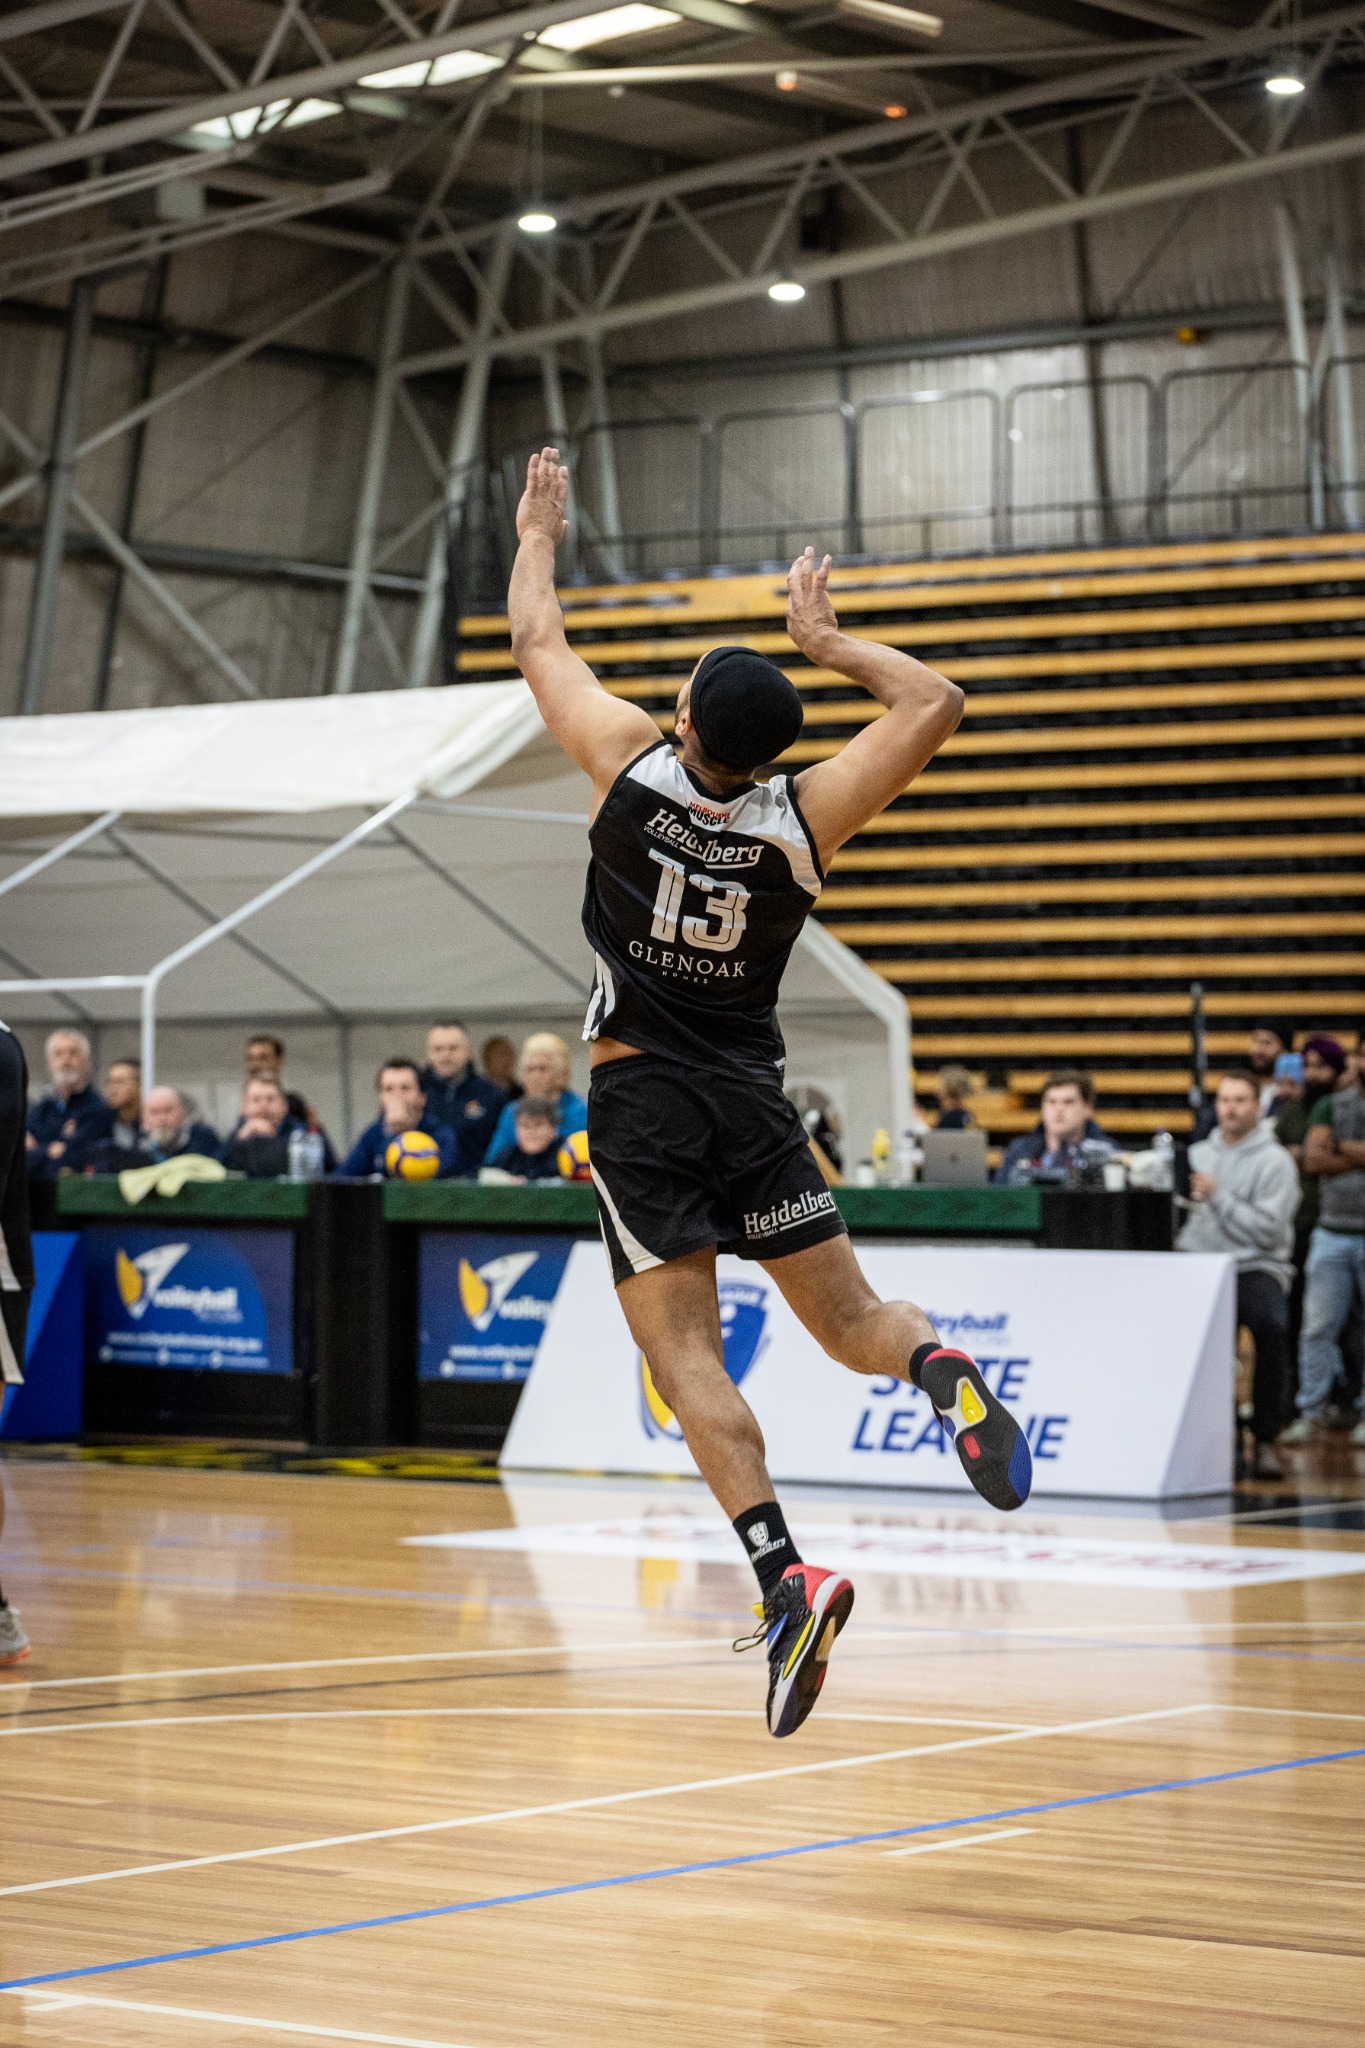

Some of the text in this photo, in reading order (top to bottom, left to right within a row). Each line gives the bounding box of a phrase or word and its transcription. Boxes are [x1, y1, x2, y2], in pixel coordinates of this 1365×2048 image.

[688, 805, 730, 827] MUSCLE
[689, 801, 731, 819] MELBOURNE
[643, 825, 679, 848] VOLLEYBALL
[648, 848, 751, 953] 13
[628, 940, 746, 978] GLENOAK
[662, 970, 708, 985] HOMES
[852, 1408, 1069, 1460] LEAE
